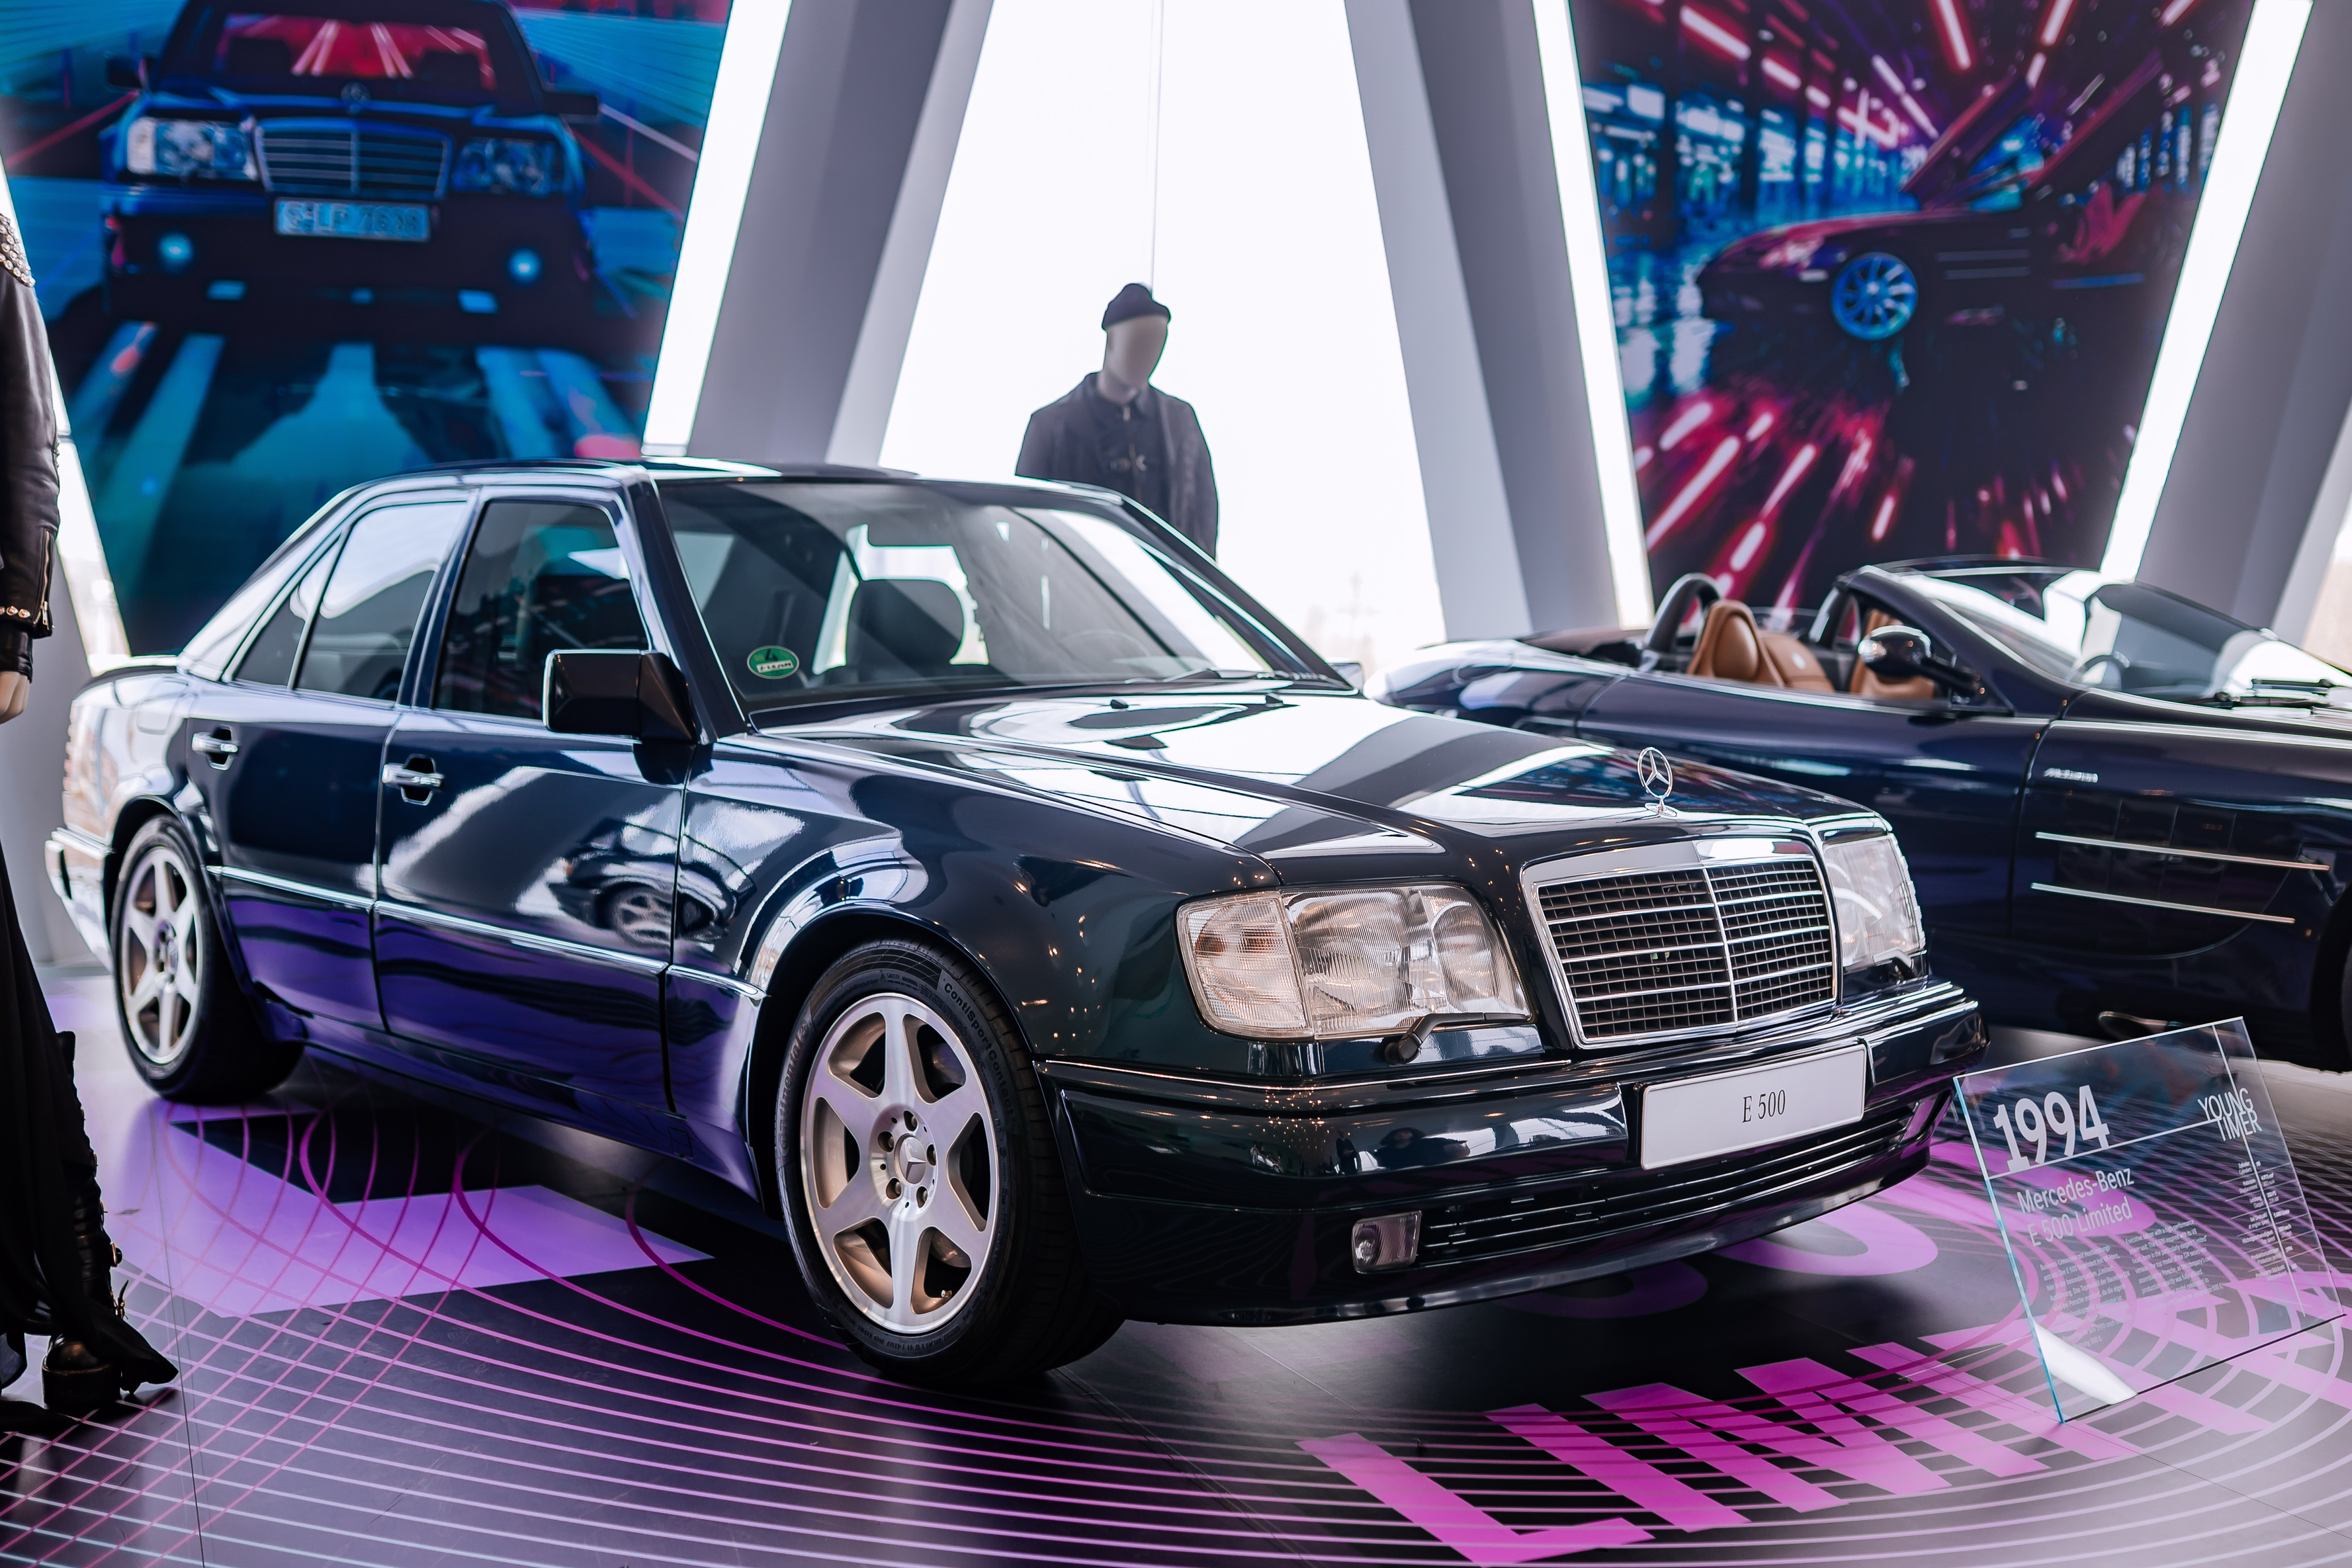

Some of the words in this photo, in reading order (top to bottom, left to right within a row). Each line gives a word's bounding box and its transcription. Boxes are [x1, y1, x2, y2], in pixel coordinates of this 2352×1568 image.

[944, 982, 1015, 1117] ContiSportContact
[1741, 1096, 1752, 1123] E
[1758, 1089, 1786, 1120] 500
[2197, 1088, 2255, 1122] YOUNG
[1993, 1084, 2110, 1172] 1994
[2214, 1110, 2263, 1143] TIMER
[2017, 1166, 2134, 1214] Mercedes-Benz
[2028, 1223, 2042, 1247] E
[2043, 1214, 2073, 1242] 500
[2074, 1196, 2132, 1235] Limited
[2069, 1297, 2084, 1307] Porsche
